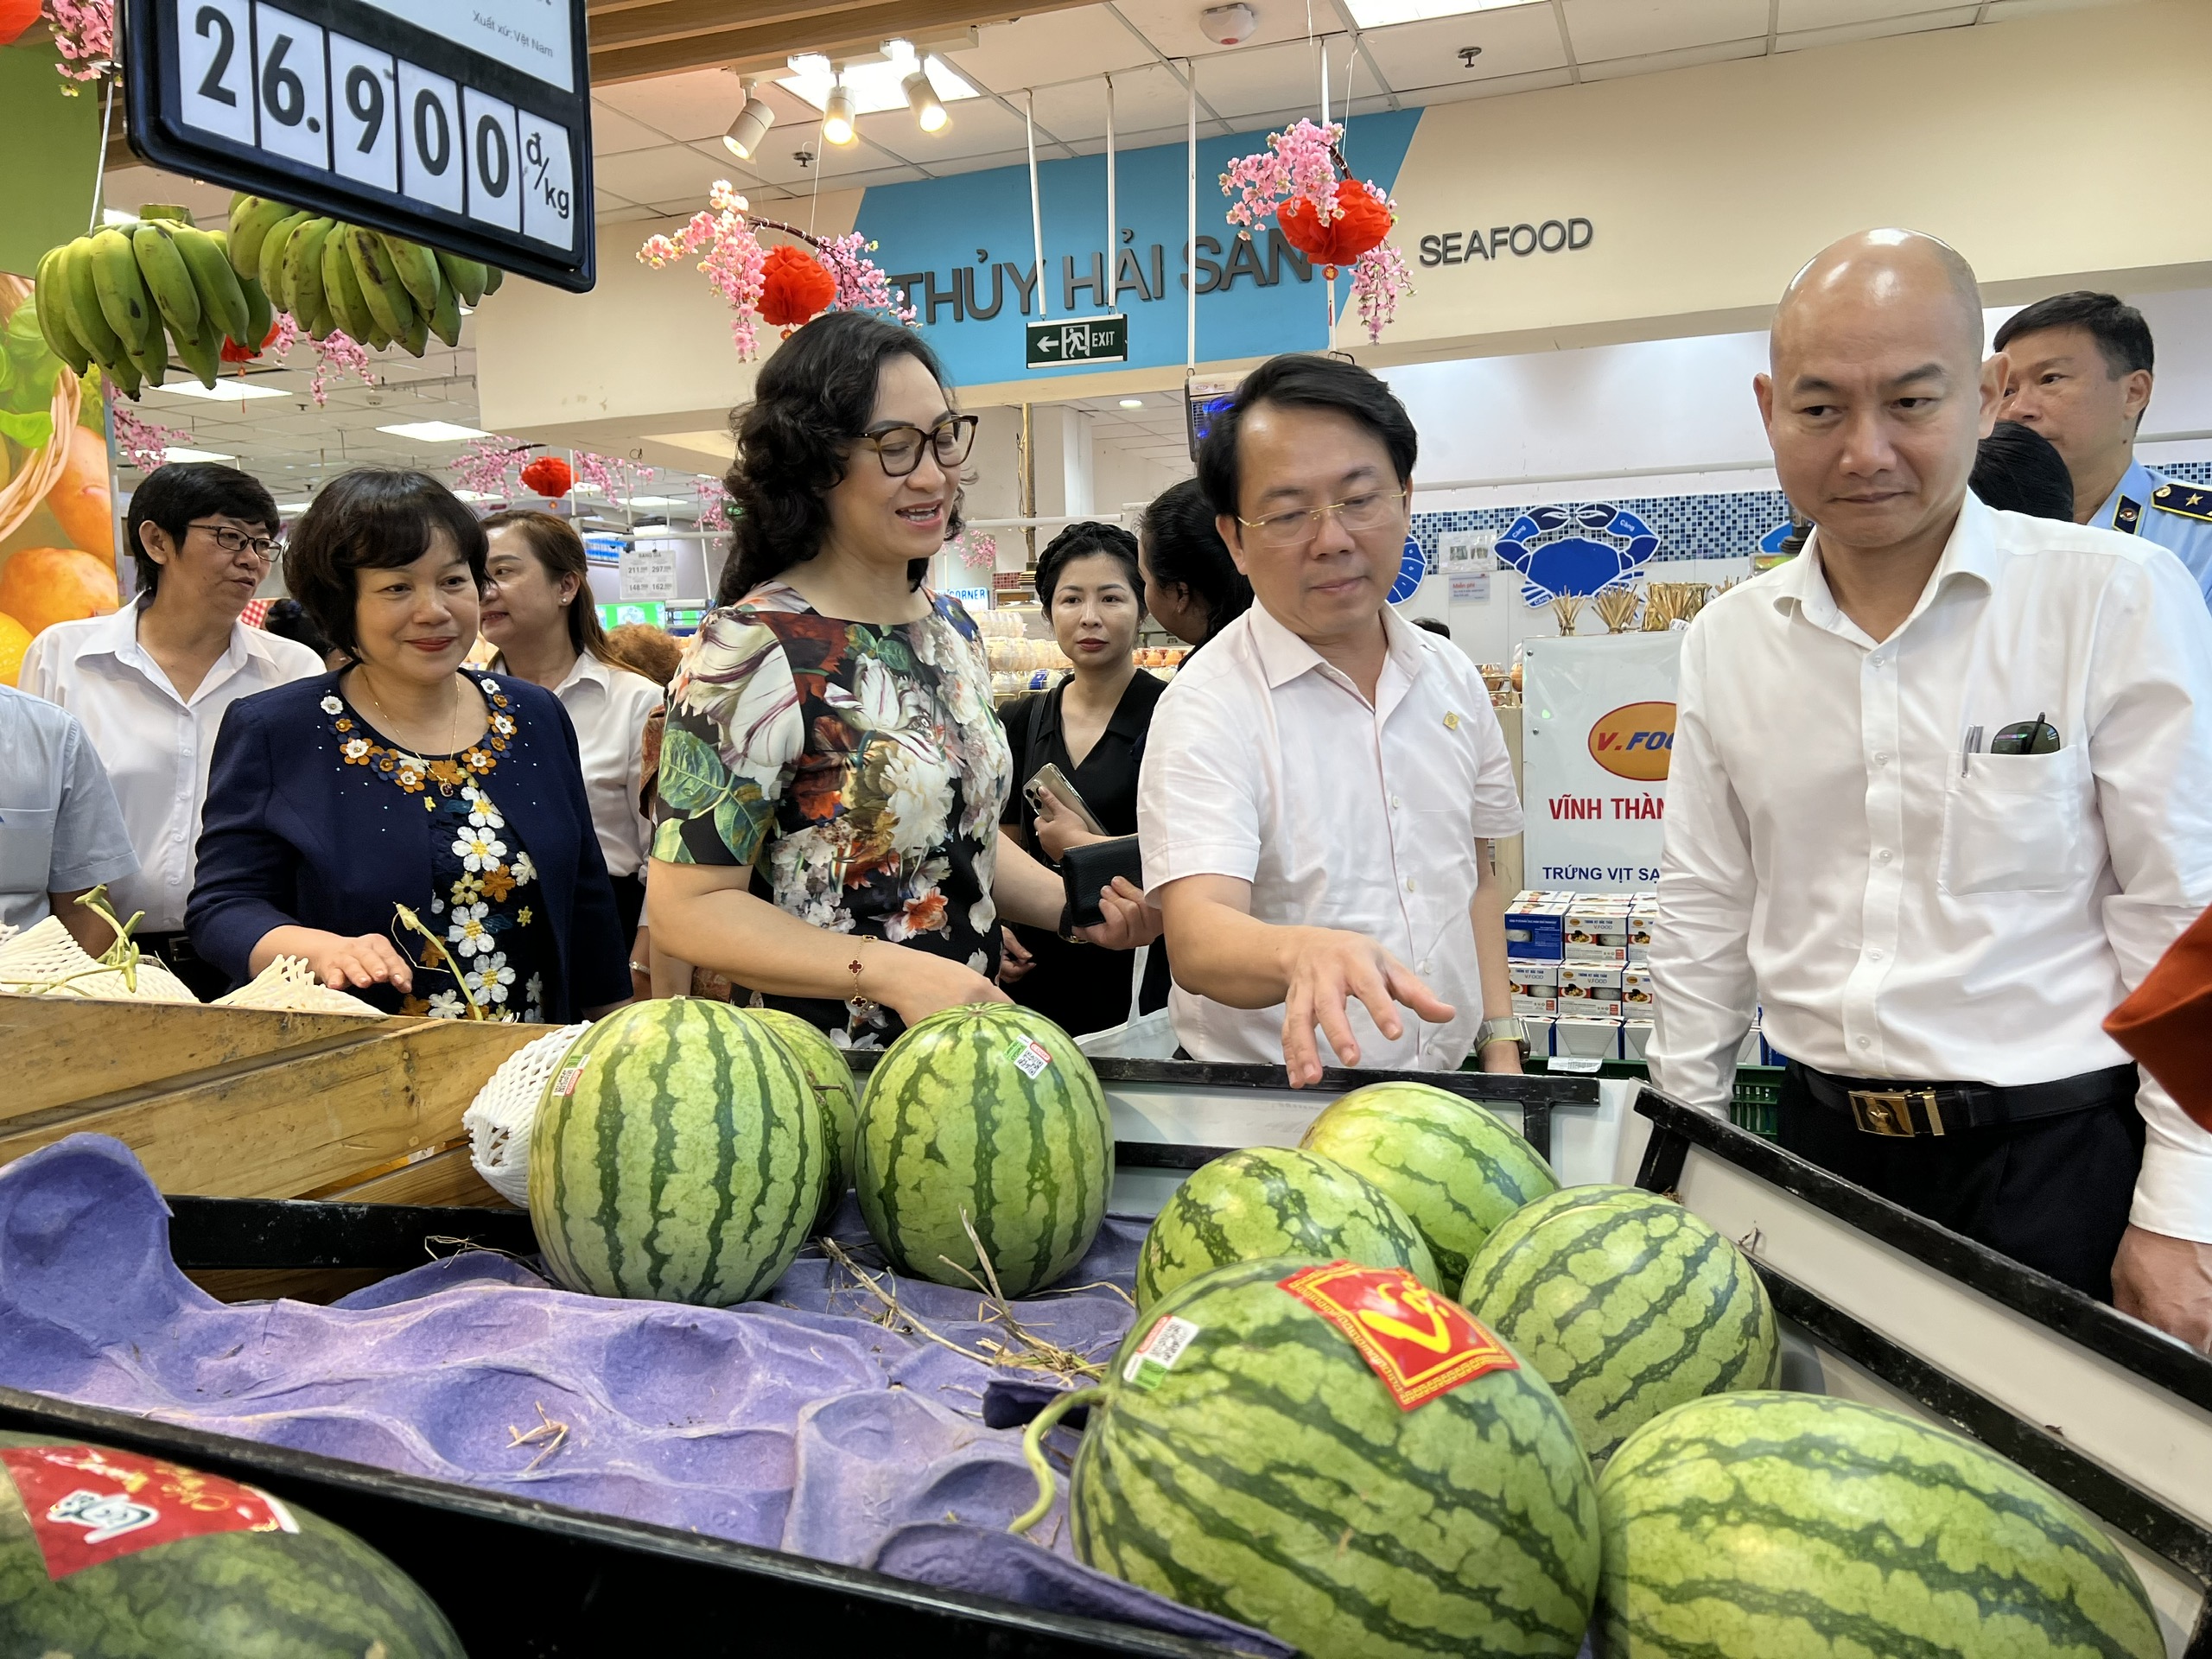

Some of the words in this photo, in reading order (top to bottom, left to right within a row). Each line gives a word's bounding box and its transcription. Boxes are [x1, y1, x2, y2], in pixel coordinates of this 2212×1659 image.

[473, 10, 495, 31] Xuất
[531, 38, 553, 57] Nam
[525, 131, 569, 219] đ/kg
[1419, 217, 1593, 266] SEAFOOD
[887, 248, 1046, 325] THỦY
[1063, 228, 1164, 309] HẢI
[1091, 330, 1116, 348] EXIT
[1548, 793, 1602, 820] VĨNH
[1542, 864, 1602, 880] TRỨNG
[1607, 868, 1633, 883] VỊT
